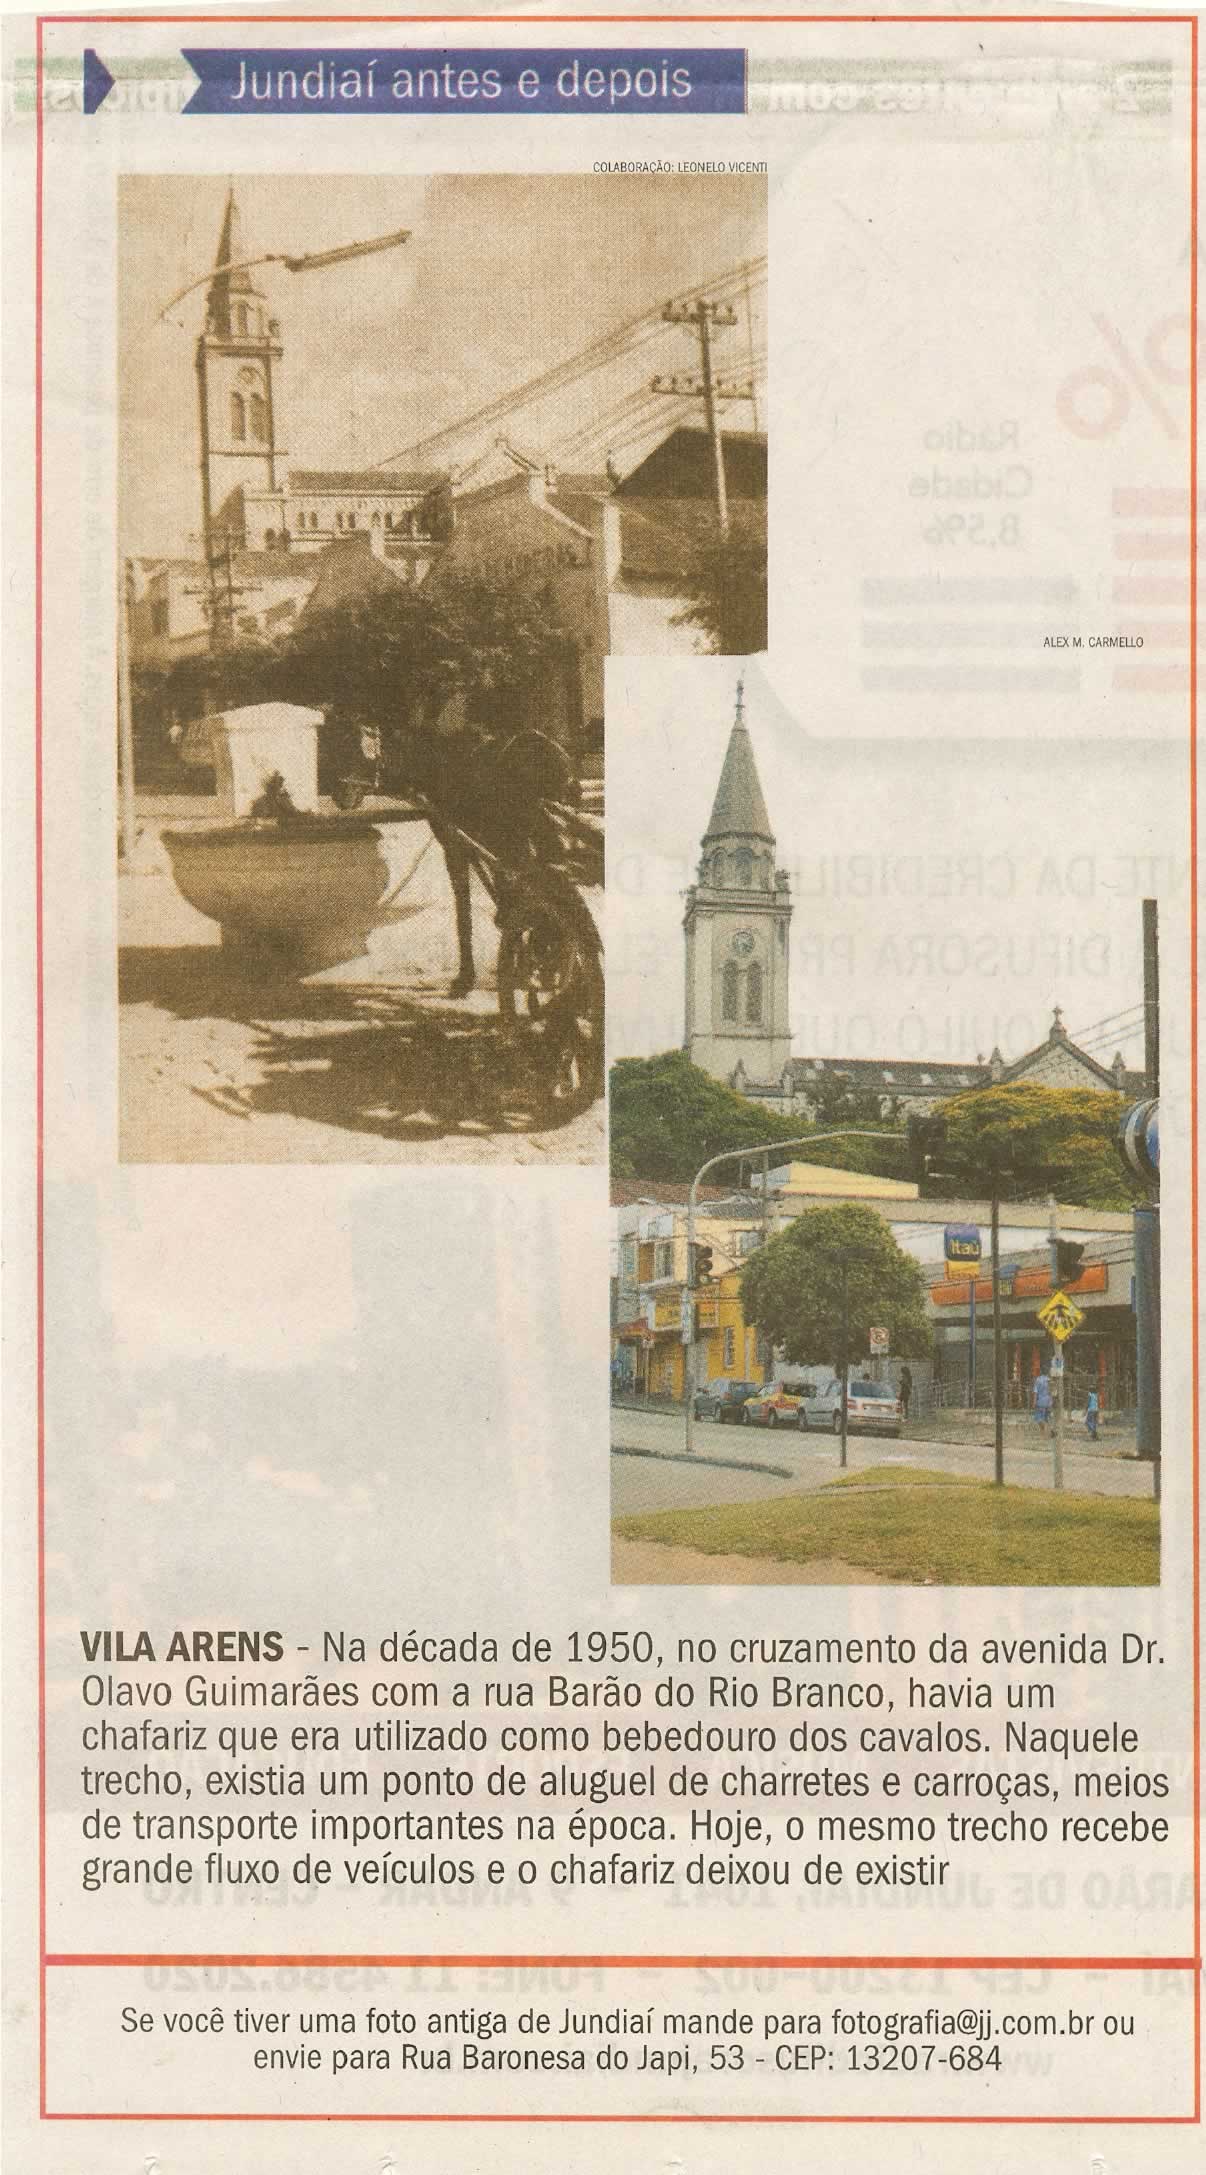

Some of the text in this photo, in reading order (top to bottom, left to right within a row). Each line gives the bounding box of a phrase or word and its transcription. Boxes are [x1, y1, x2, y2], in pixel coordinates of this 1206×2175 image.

[231, 59, 692, 105] Jundiaí antes e depois
[593, 159, 768, 175] COLABORAÇÃO: LEONELO VICENTI
[1043, 636, 1144, 648] ALEX M. CARMELLO
[80, 1631, 156, 1662] VILA
[165, 1630, 284, 1662] ARENS
[324, 1631, 366, 1663] Na
[380, 1629, 498, 1663] década
[512, 1631, 552, 1663] de
[568, 1631, 663, 1668] 1950,
[678, 1639, 717, 1663] no
[730, 1634, 916, 1664] cruzamento
[929, 1632, 967, 1664] da
[982, 1632, 1107, 1664] avenida
[1122, 1633, 1164, 1664] Dr.
[82, 1674, 1054, 1713] Olavo Guimarães com a rua Barão do Rio Branco, havia um
[82, 1719, 1138, 1760] chafariz que era utilizado como bebedouro dos cavalos. Naquele
[80, 1763, 1169, 1805] trecho, existia um ponto de aluguel de charretes e carroças, meios
[82, 1807, 1169, 1848] de transporte importantes na época. Hoje, o mesmo trecho recebe
[82, 1851, 950, 1892] grande fluxo de veículos e o chafariz deixou de existir
[121, 2006, 1134, 2041] Se você tiver uma foto antiga de Jundiaí mande para fotografia@jj.com.br ou
[254, 2043, 322, 2070] envie
[333, 2049, 390, 2075] para
[402, 2043, 451, 2070] Rua
[463, 2044, 585, 2070] Baronesa
[596, 2044, 629, 2070] do
[637, 2044, 698, 2076] Japi,
[710, 2044, 745, 2071] 53
[775, 2044, 833, 2071] CEP:
[848, 2044, 1002, 2071] 13207-684
